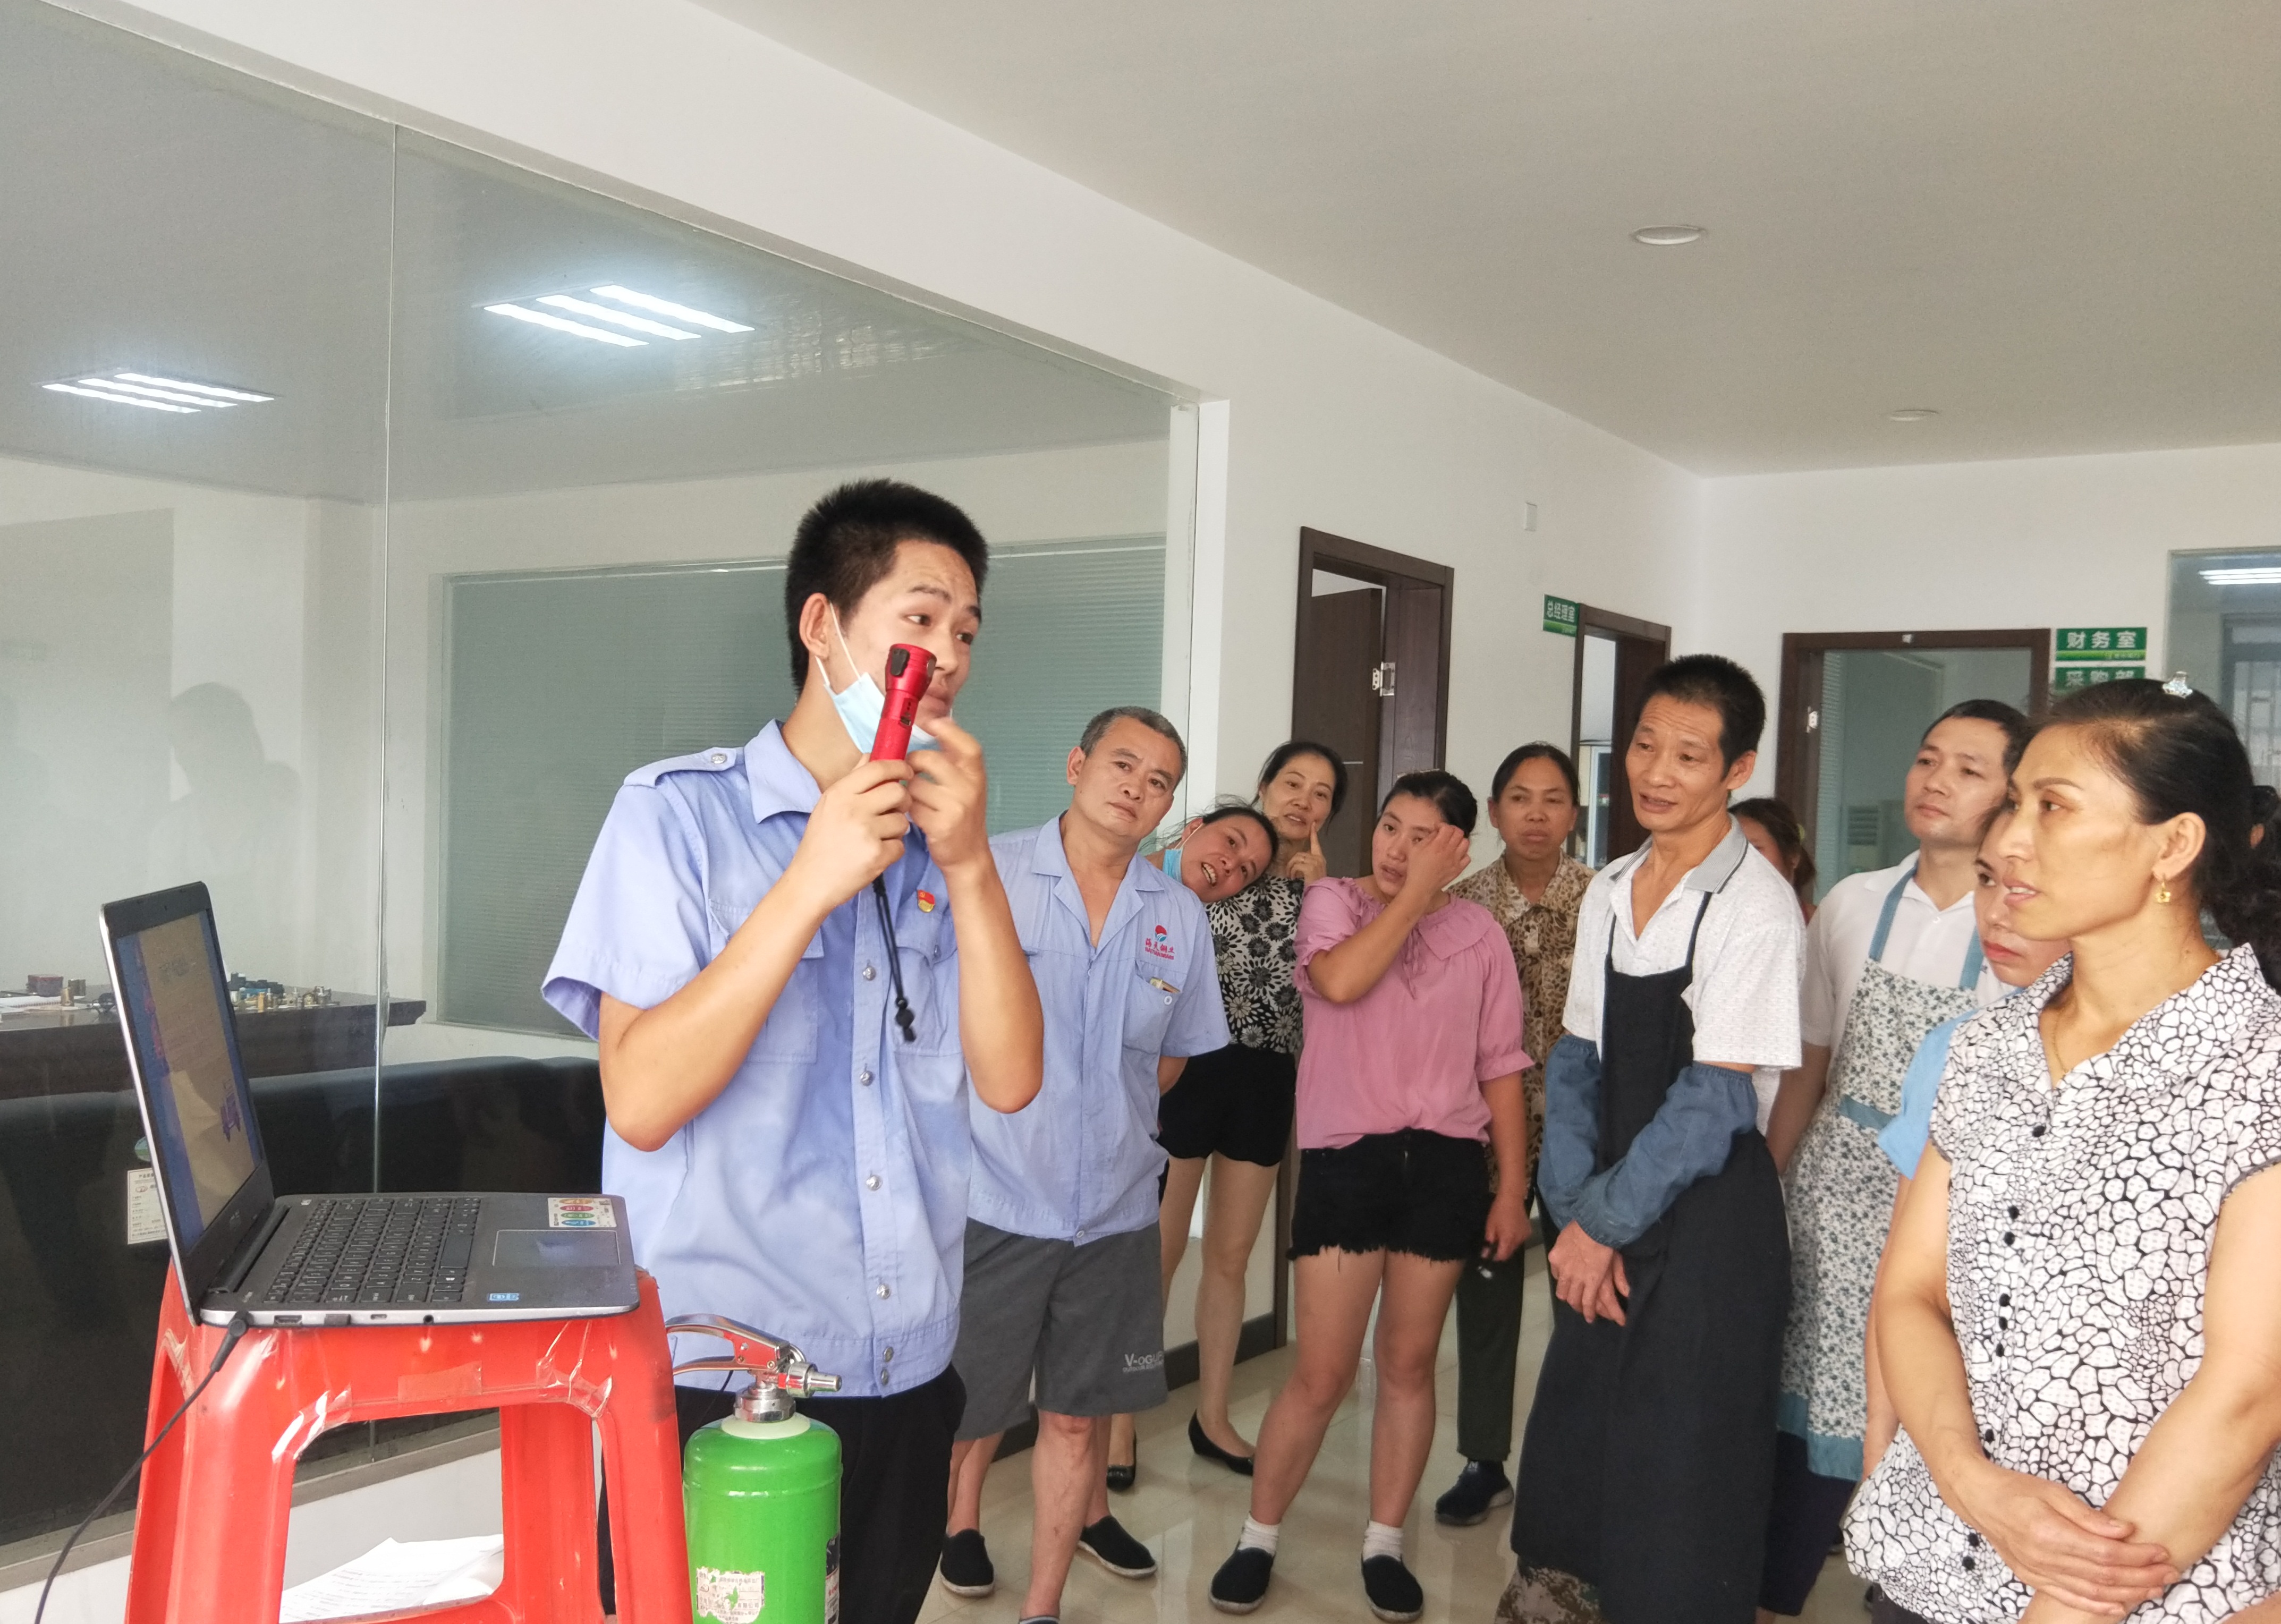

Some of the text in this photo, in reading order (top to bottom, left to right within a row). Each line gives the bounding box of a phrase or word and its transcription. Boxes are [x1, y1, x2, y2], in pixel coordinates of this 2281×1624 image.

[1546, 600, 1575, 623] 总经理室
[2066, 631, 2136, 649] 财务室
